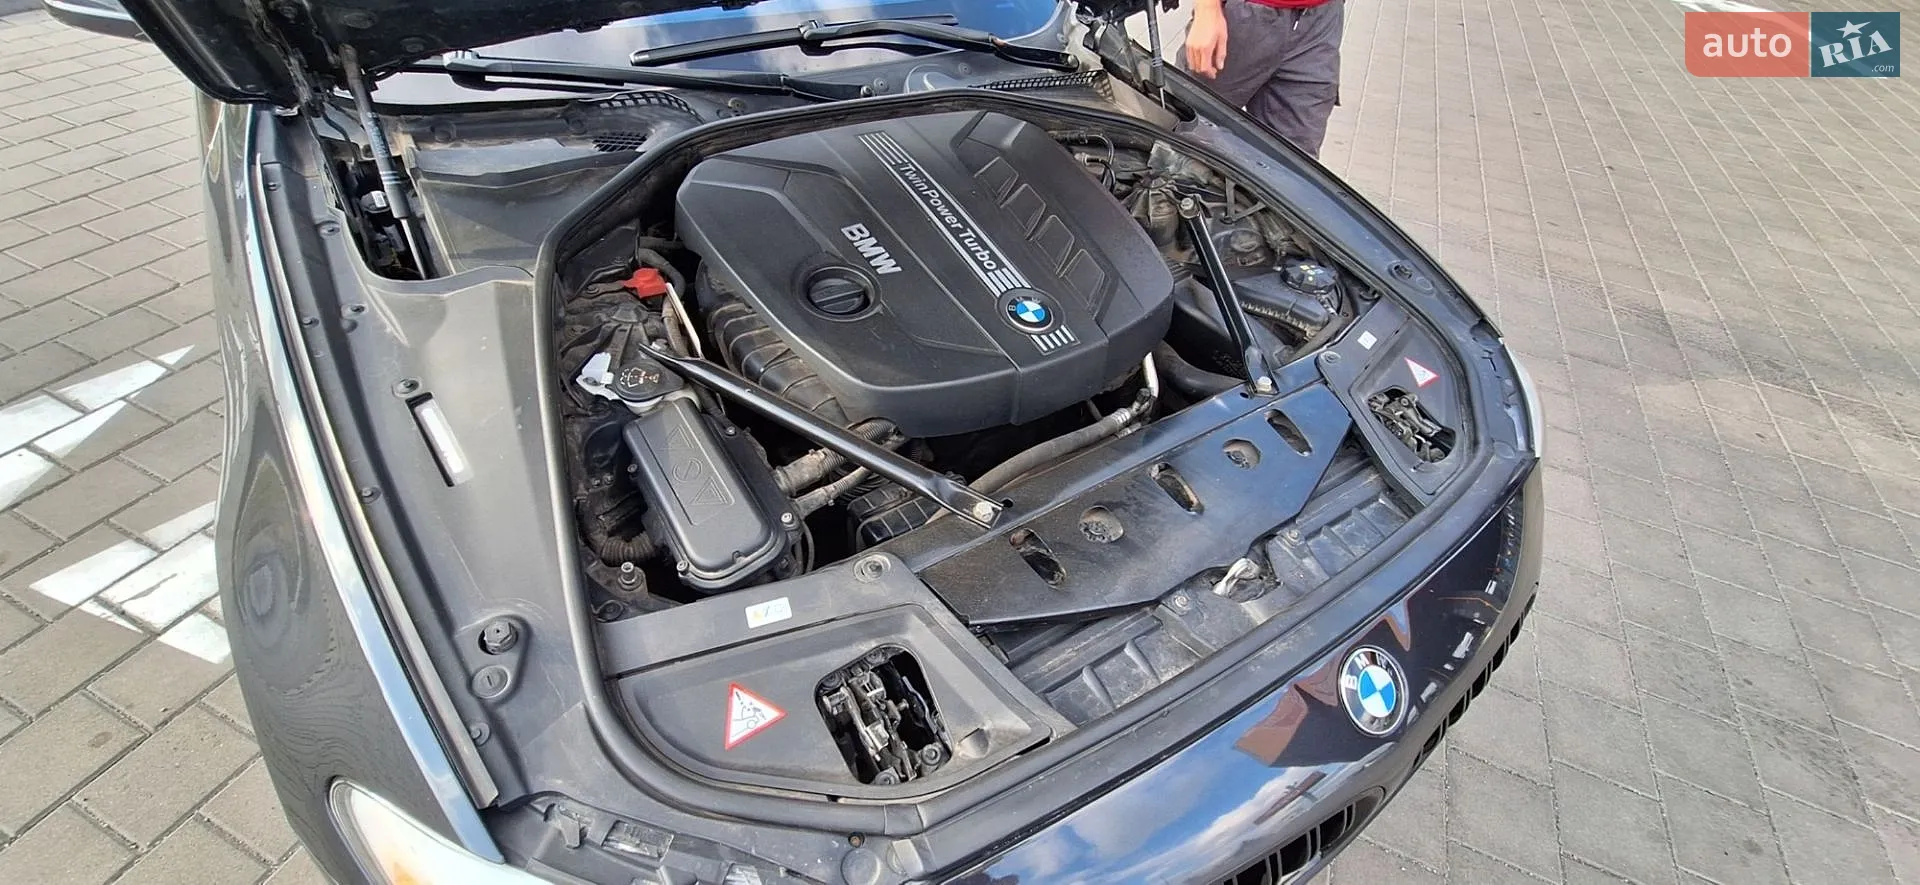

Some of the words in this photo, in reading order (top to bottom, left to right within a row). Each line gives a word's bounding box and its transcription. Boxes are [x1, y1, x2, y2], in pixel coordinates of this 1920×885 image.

[841, 223, 902, 275] BMW
[900, 162, 963, 229] TwinPower
[959, 228, 997, 270] Turbo
